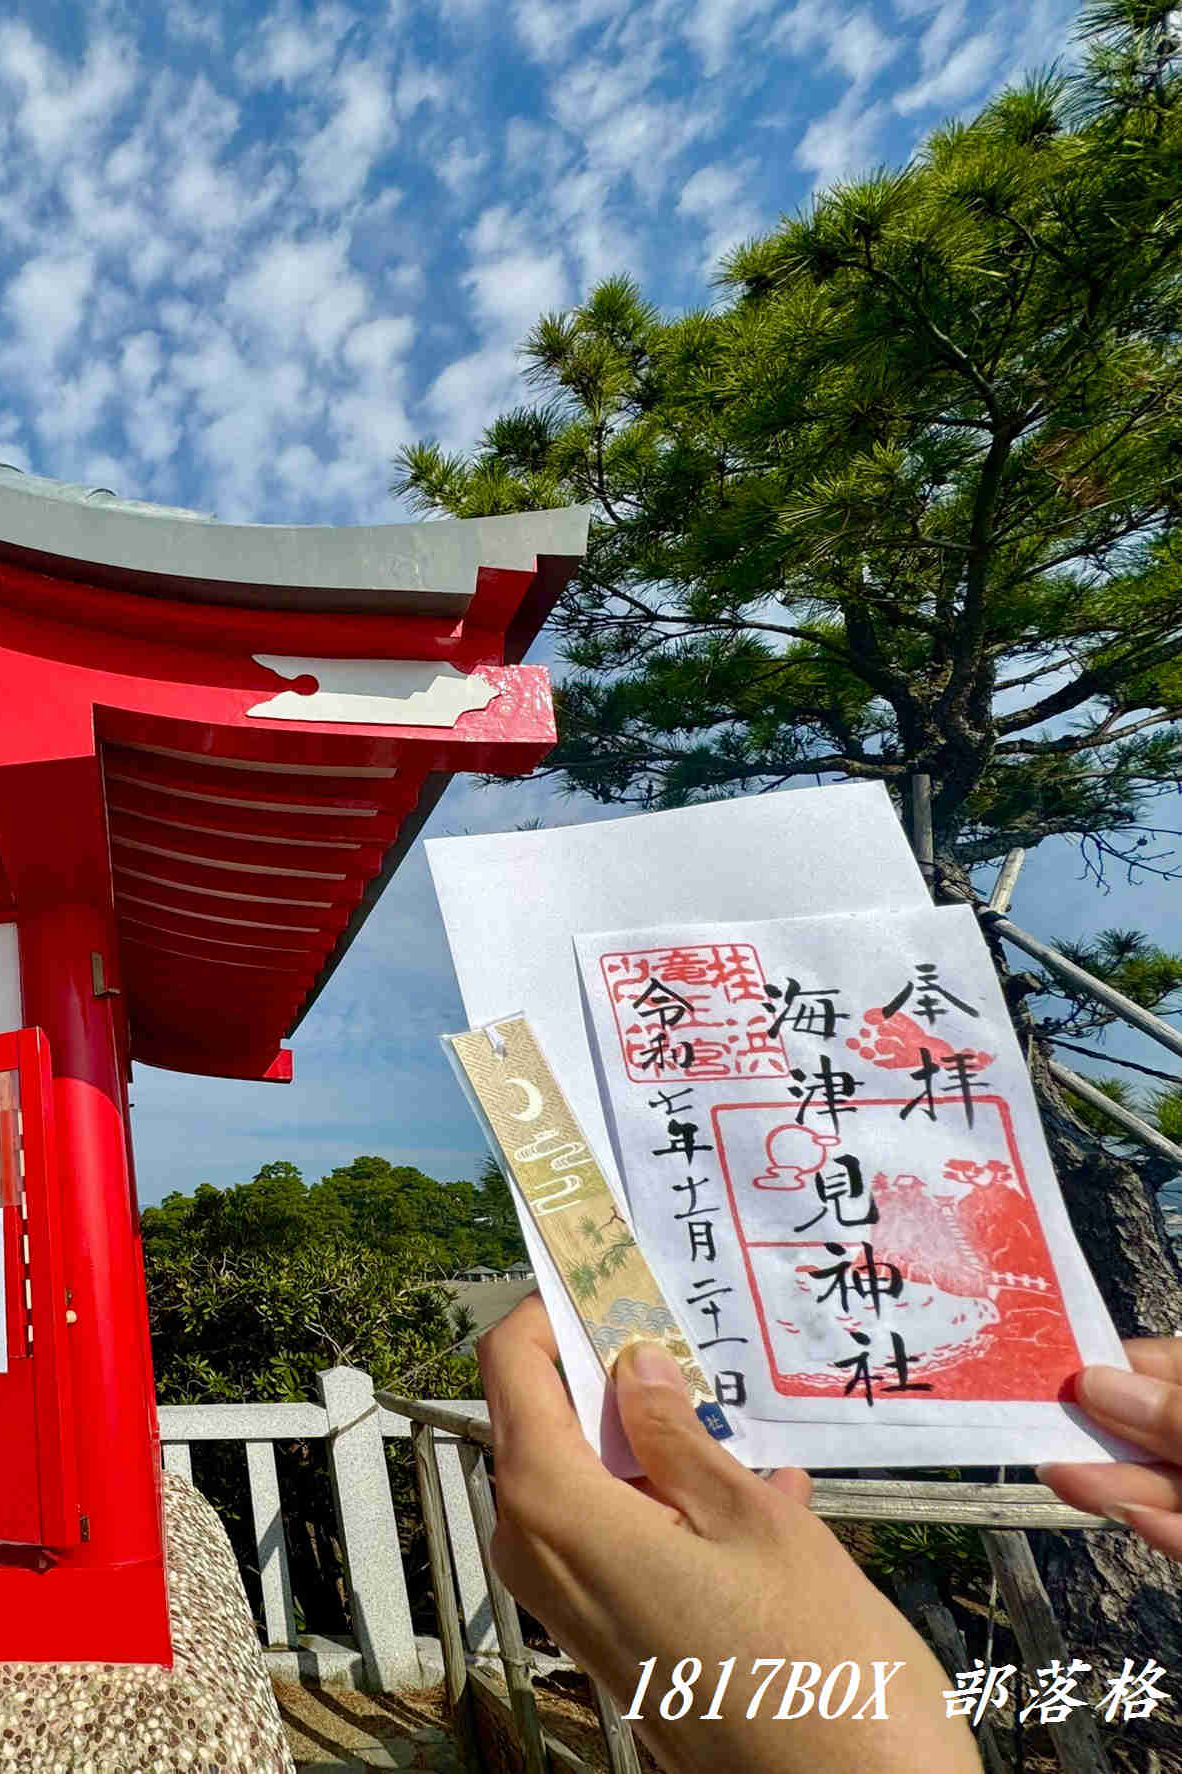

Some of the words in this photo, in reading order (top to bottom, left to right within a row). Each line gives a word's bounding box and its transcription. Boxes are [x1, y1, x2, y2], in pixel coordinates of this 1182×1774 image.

[762, 976, 934, 1407] 海津見神社
[881, 963, 994, 1130] 奉拝
